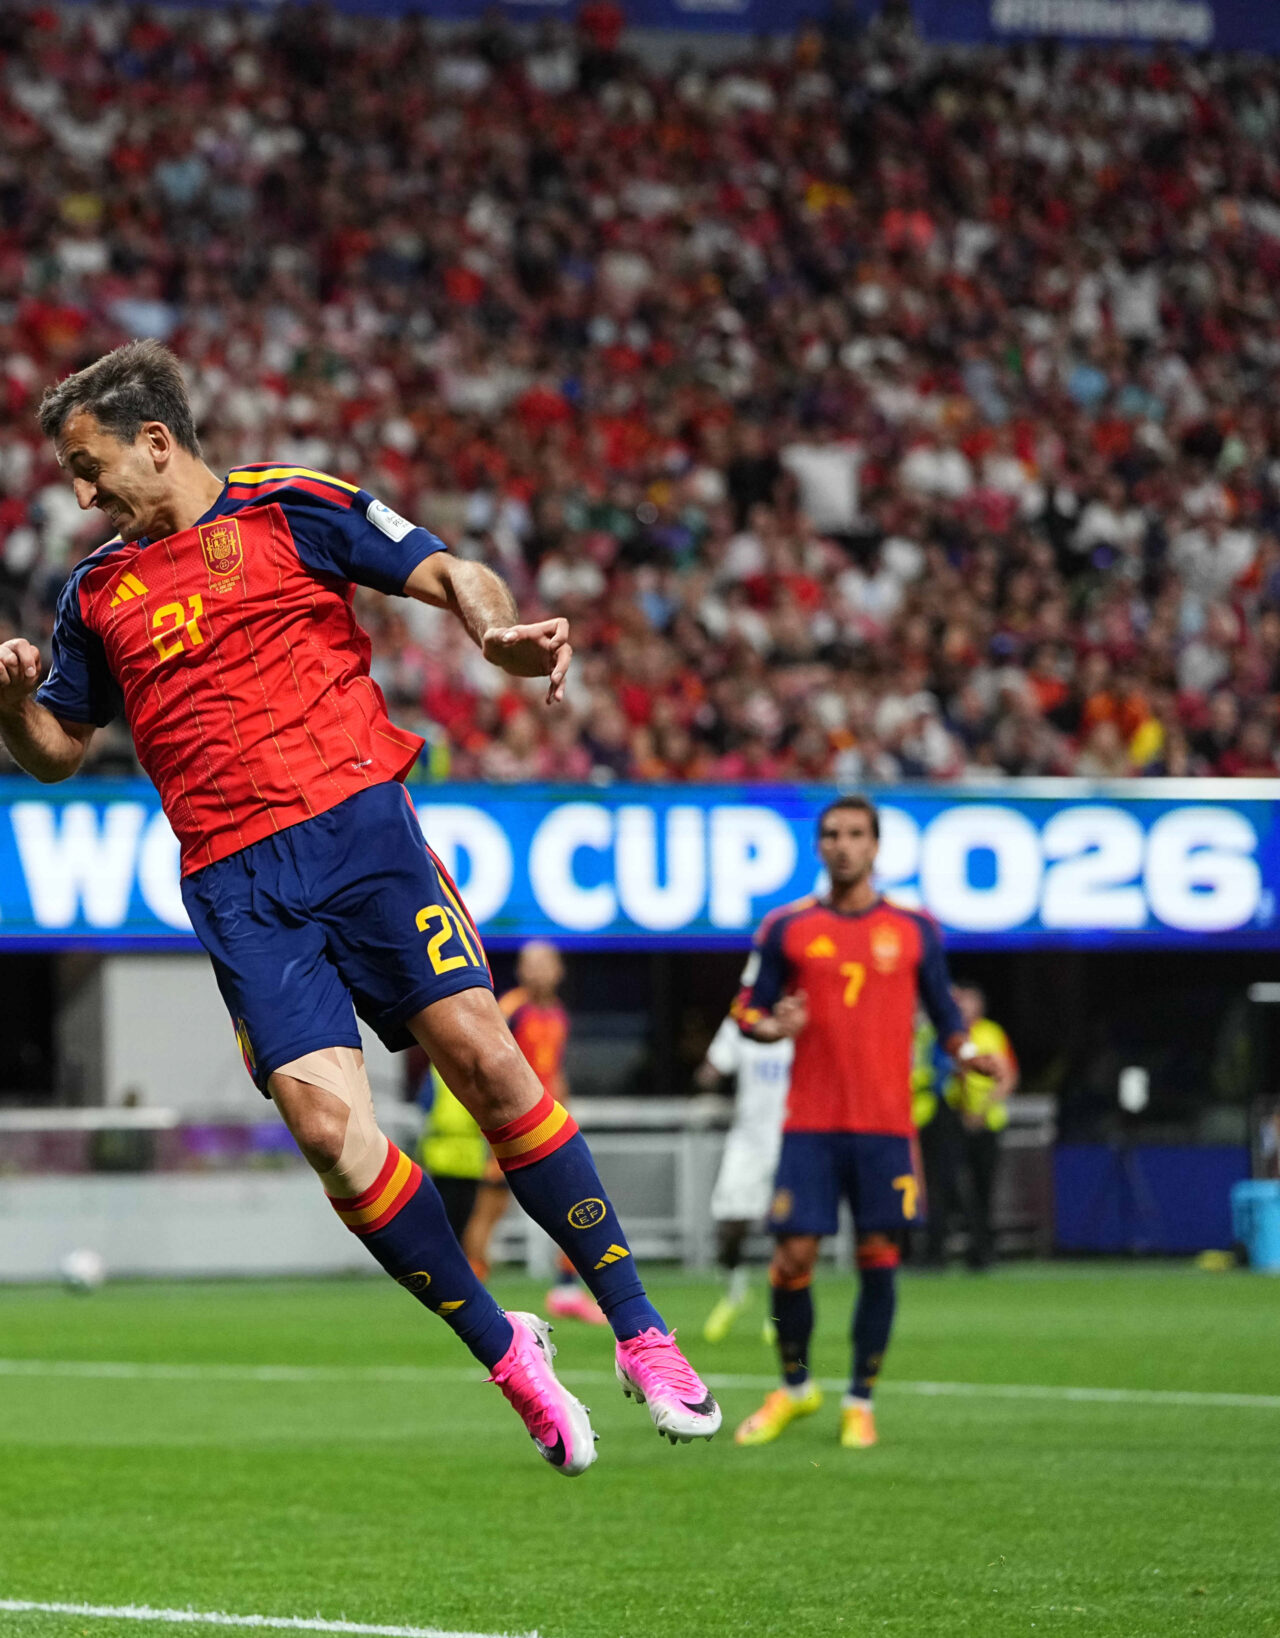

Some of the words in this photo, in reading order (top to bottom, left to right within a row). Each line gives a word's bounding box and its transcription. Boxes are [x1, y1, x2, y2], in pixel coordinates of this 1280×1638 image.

[152, 593, 205, 663] 21
[528, 802, 798, 931] CUP
[415, 904, 480, 975] 21
[839, 961, 866, 1008] 7
[892, 1174, 918, 1220] 7
